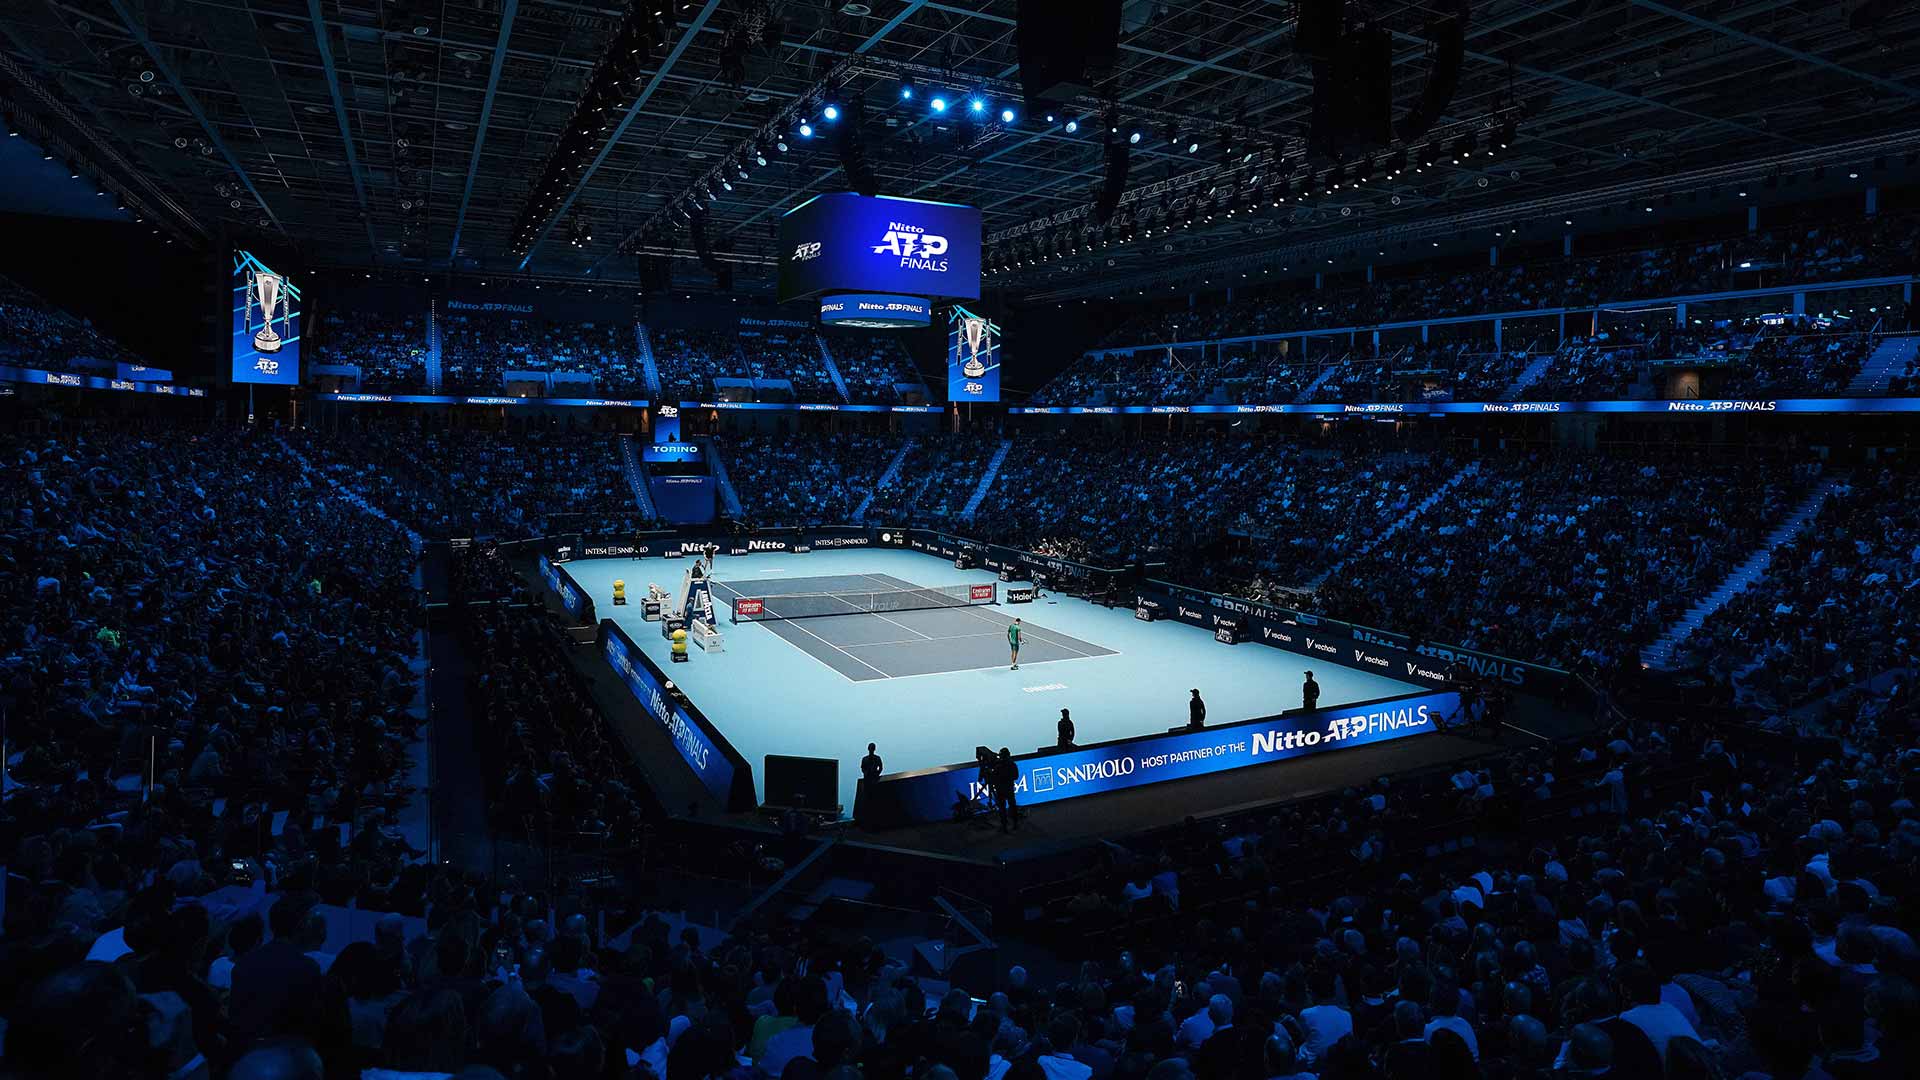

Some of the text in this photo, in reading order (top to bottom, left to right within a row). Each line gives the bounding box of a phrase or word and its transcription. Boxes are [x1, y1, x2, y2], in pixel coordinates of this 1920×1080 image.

[889, 222, 924, 233] Nitto
[870, 231, 948, 258] ATP
[900, 257, 948, 272] FINALS
[448, 300, 479, 311] Nitto
[858, 302, 884, 310] Nitto
[902, 304, 922, 313] FINALS
[1344, 404, 1365, 412] Nitto
[1381, 404, 1404, 412] FINALS
[1483, 403, 1560, 411] Nitto ATP FINALS
[1668, 401, 1777, 411] Nitto ATP FINALS
[681, 542, 720, 553] Nito
[748, 540, 786, 550] Nitto
[585, 548, 607, 556] INTESA
[1314, 643, 1337, 654] vechain
[1364, 655, 1389, 667] vechain
[1418, 669, 1445, 681] vechain
[650, 687, 670, 725] Nitto
[682, 726, 709, 770] FINALS
[1057, 756, 1135, 787] SANPAOLO
[1140, 754, 1168, 769] HOST
[1170, 747, 1213, 764] PARTNER
[1214, 744, 1227, 757] OF
[1228, 741, 1246, 753] THE
[1251, 729, 1321, 756] Nitto
[1321, 714, 1368, 743] ATP
[1368, 705, 1429, 736] FINALS
